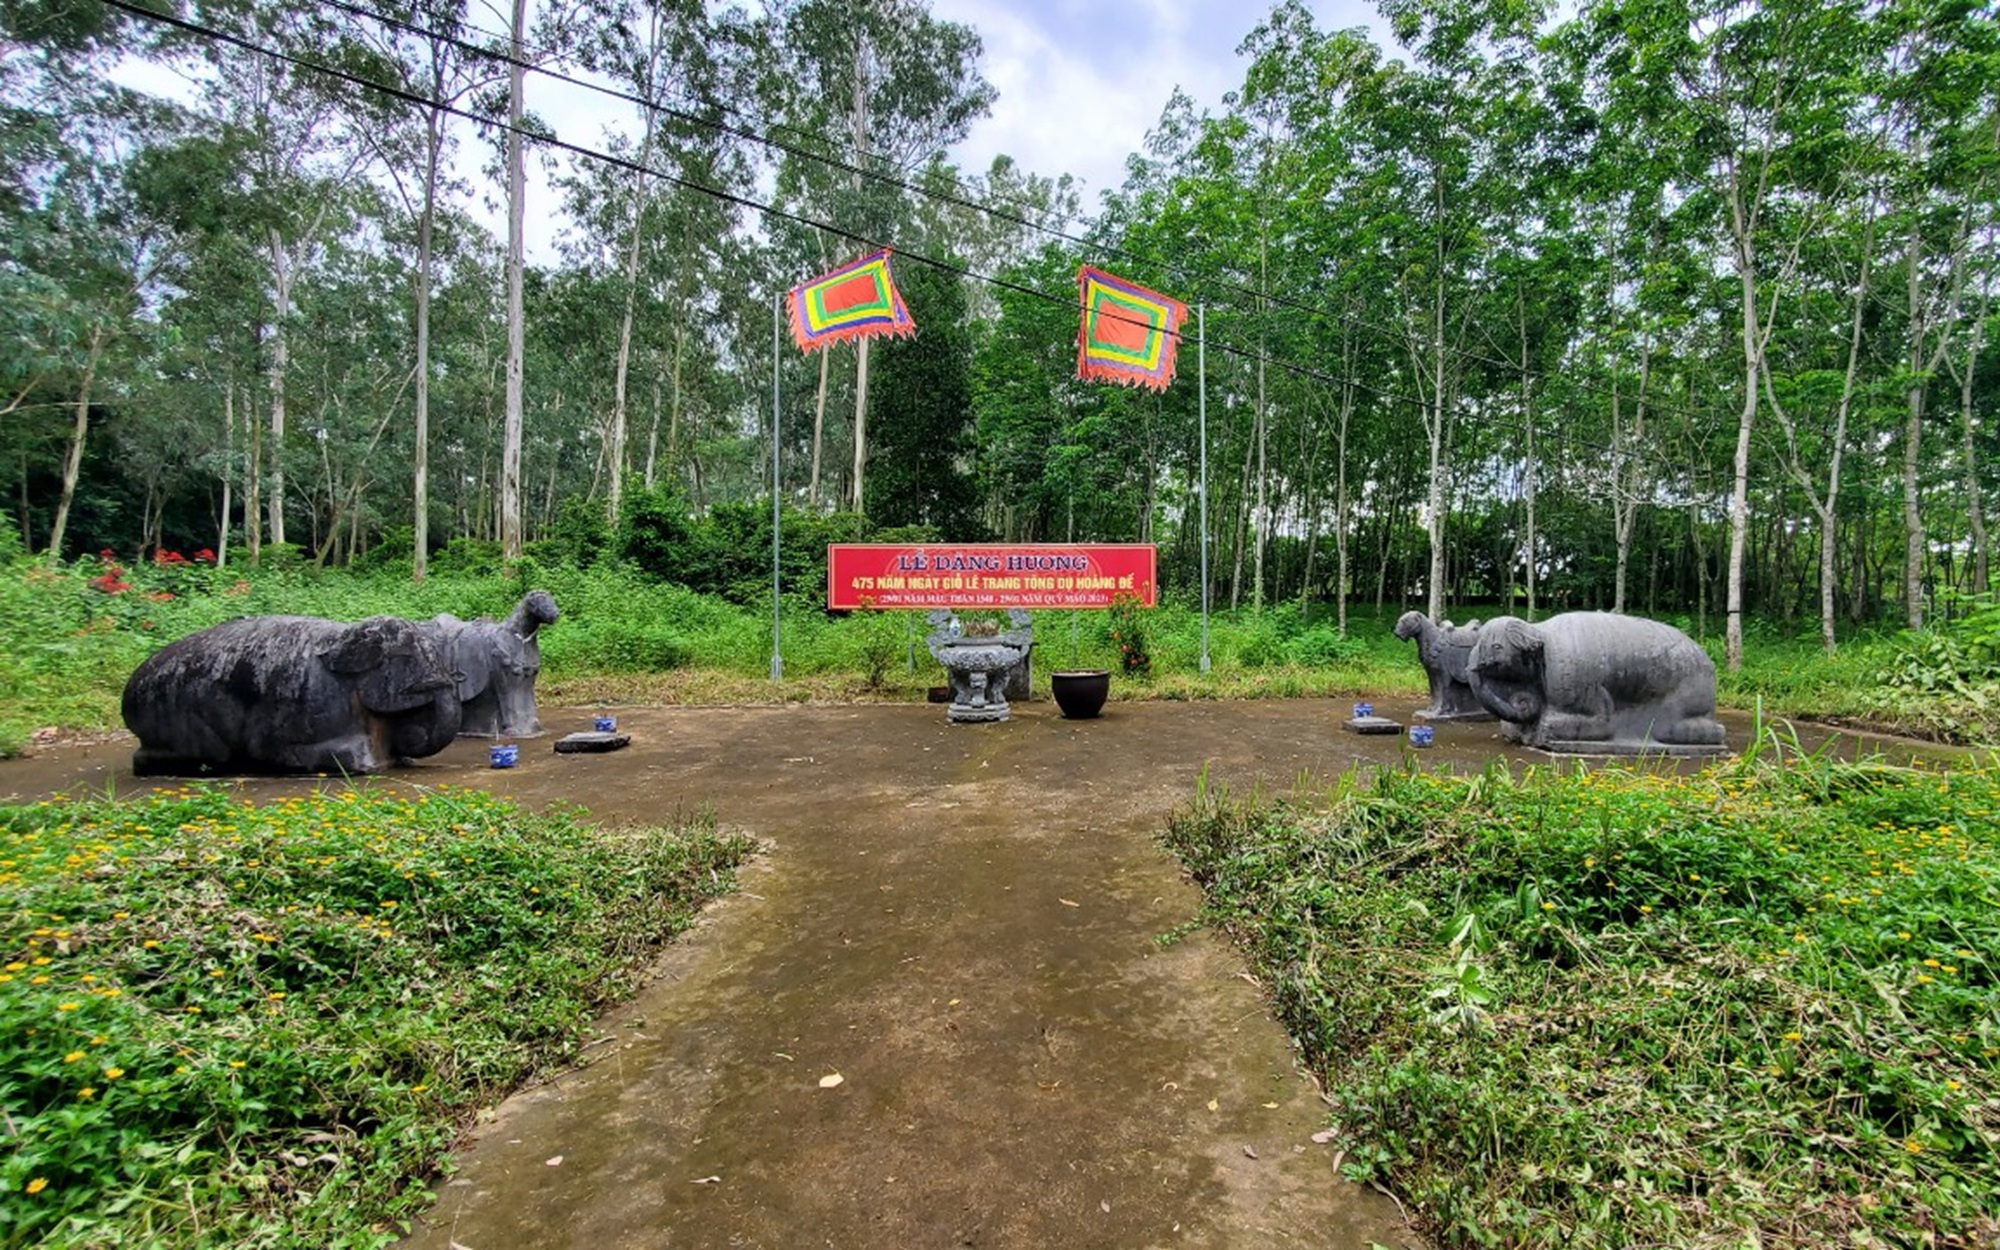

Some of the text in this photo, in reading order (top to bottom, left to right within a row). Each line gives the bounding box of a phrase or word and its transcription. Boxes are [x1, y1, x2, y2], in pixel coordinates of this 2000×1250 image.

[935, 551, 1000, 570] DÂNG
[852, 577, 874, 590] 475
[877, 574, 905, 590] NĂM
[908, 574, 940, 590] NGÀY
[966, 574, 980, 590] LÊ
[982, 577, 1021, 590] TRANG
[1024, 574, 1055, 590] TÔNG
[1057, 577, 1074, 591] DỤ
[1076, 573, 1116, 590] HOÀNG
[1119, 572, 1135, 590] ĐẾ
